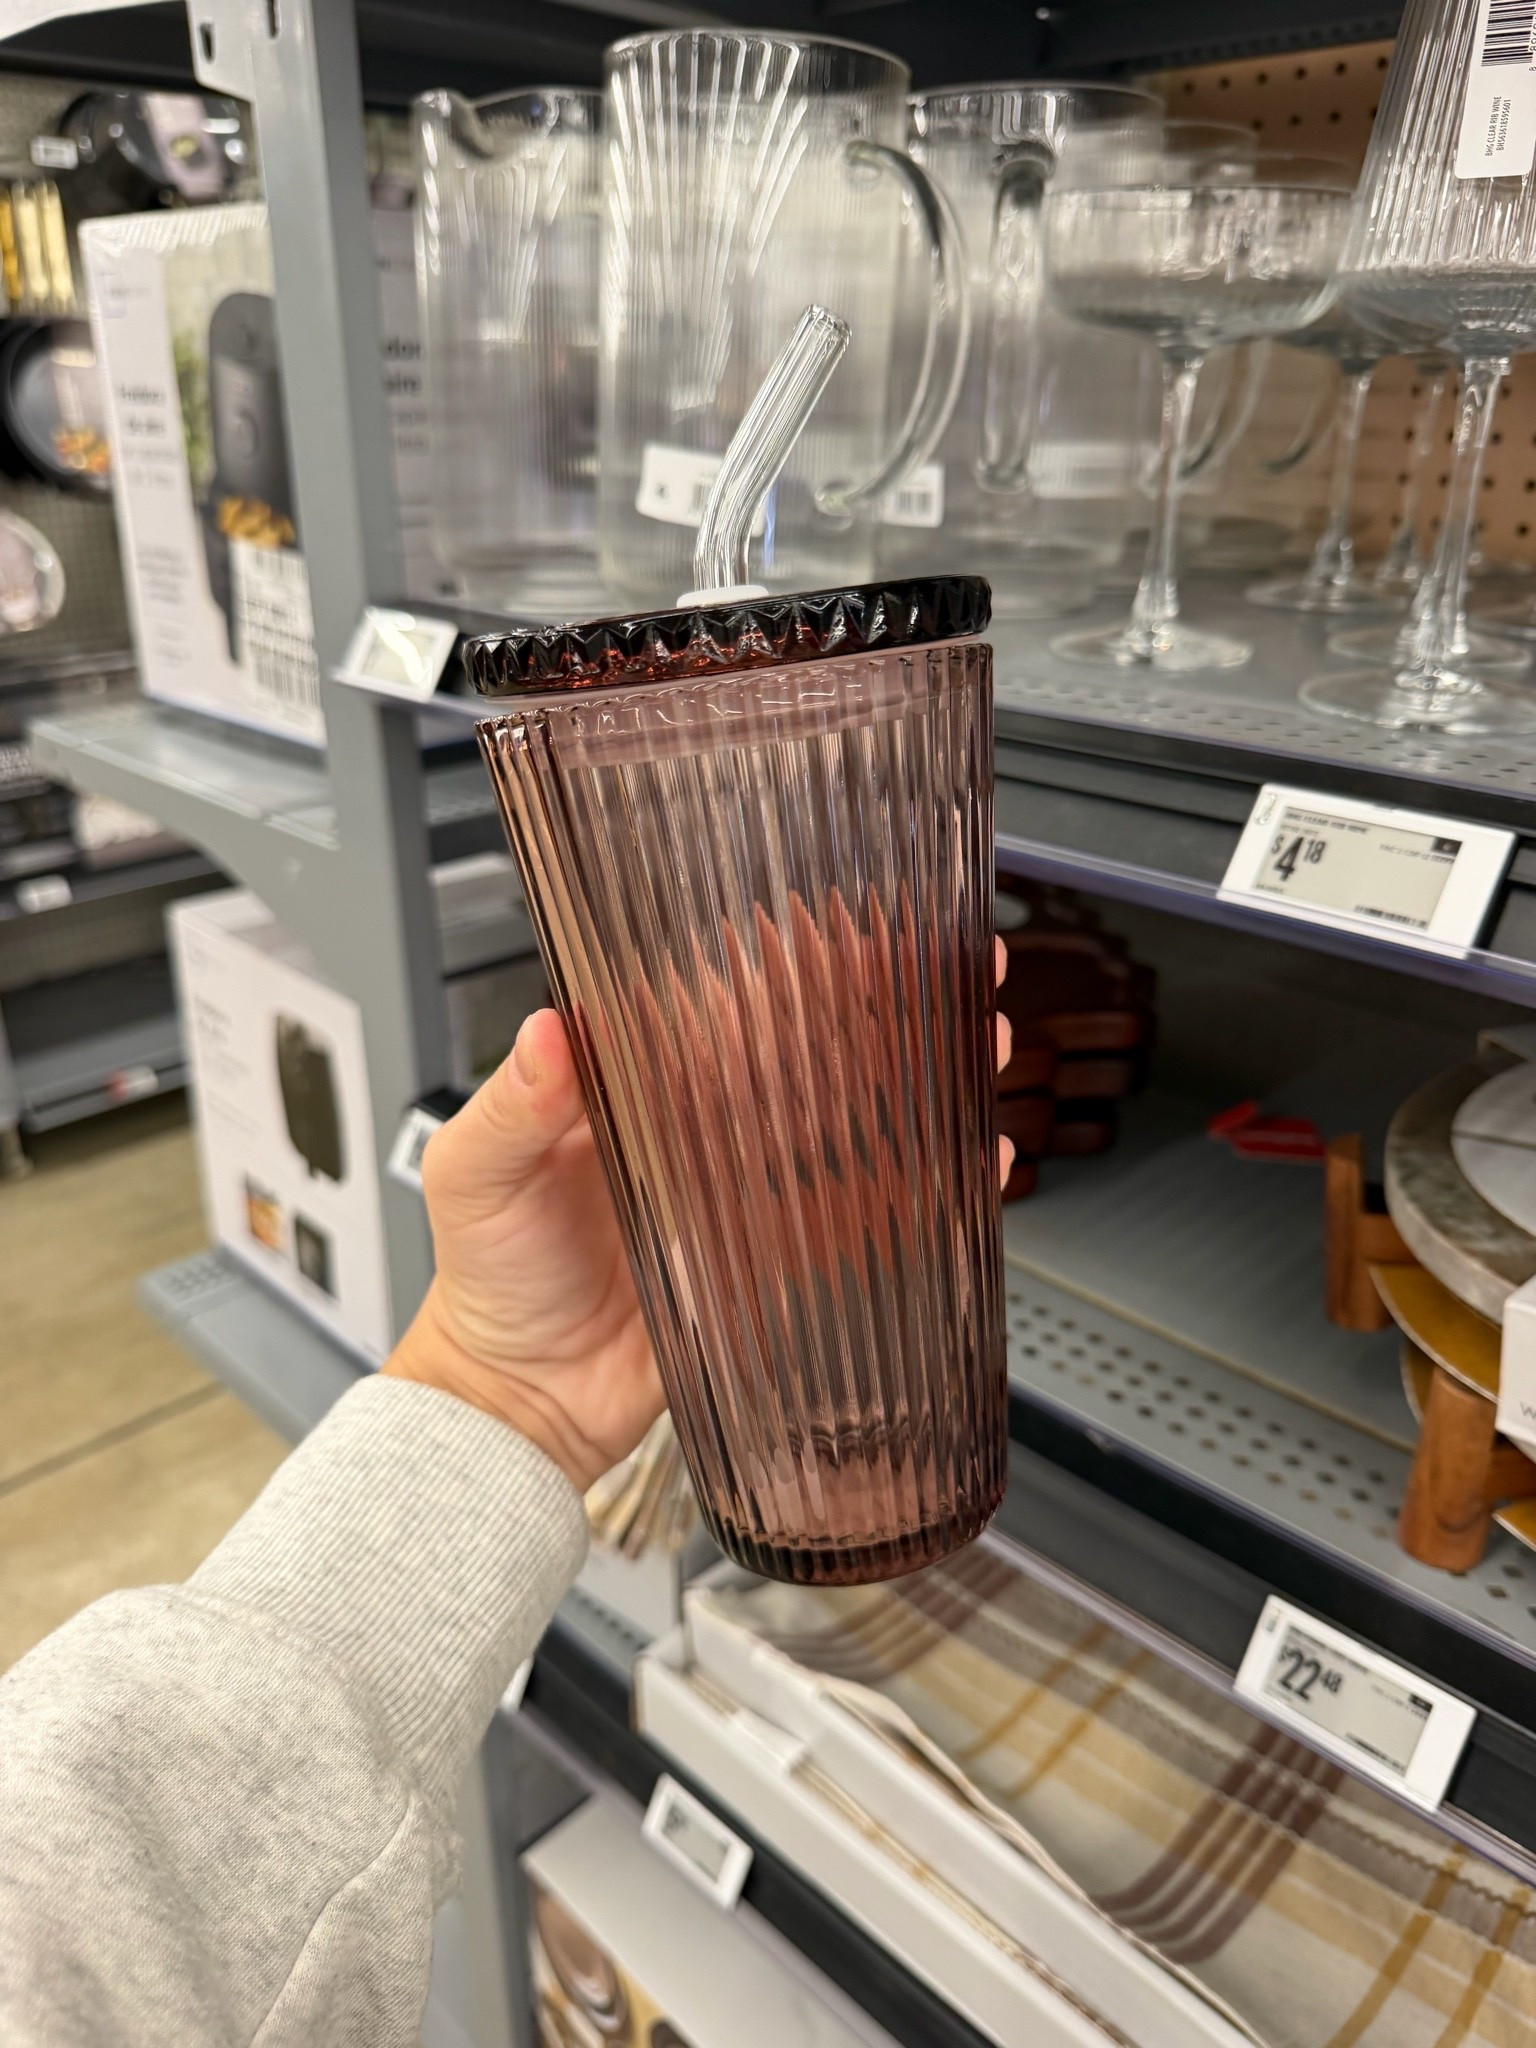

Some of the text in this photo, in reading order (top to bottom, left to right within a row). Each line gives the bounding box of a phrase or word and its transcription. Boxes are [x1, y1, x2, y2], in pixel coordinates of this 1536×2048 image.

[1485, 96, 1501, 156] BHG CLEAR RIB WINE
